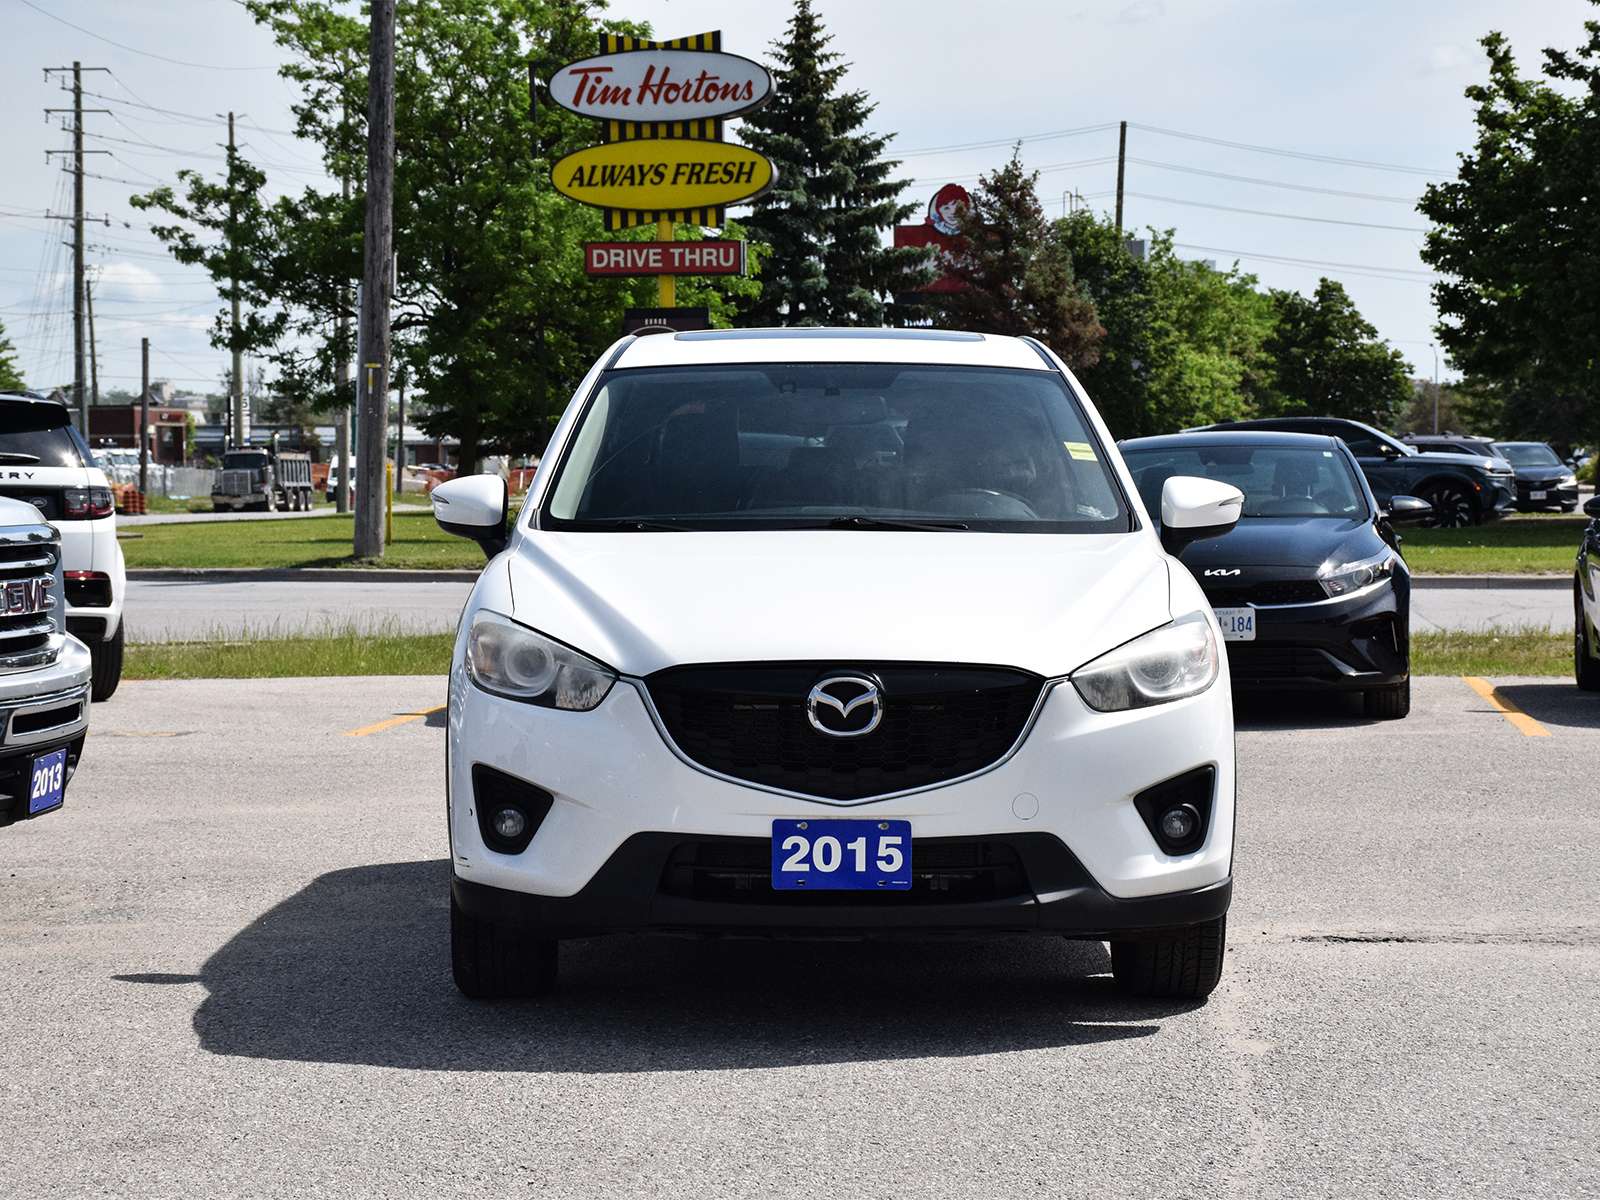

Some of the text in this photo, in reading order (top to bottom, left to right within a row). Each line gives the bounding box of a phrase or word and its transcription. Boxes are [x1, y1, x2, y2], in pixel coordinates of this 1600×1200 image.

[569, 64, 753, 107] Tim Hortons
[567, 160, 757, 188] ALWAYS FRESH
[592, 247, 735, 269] DRIVE THRU
[5, 575, 57, 614] GMC
[1230, 615, 1252, 632] 184
[32, 762, 62, 799] 2013
[781, 835, 904, 873] 2015
